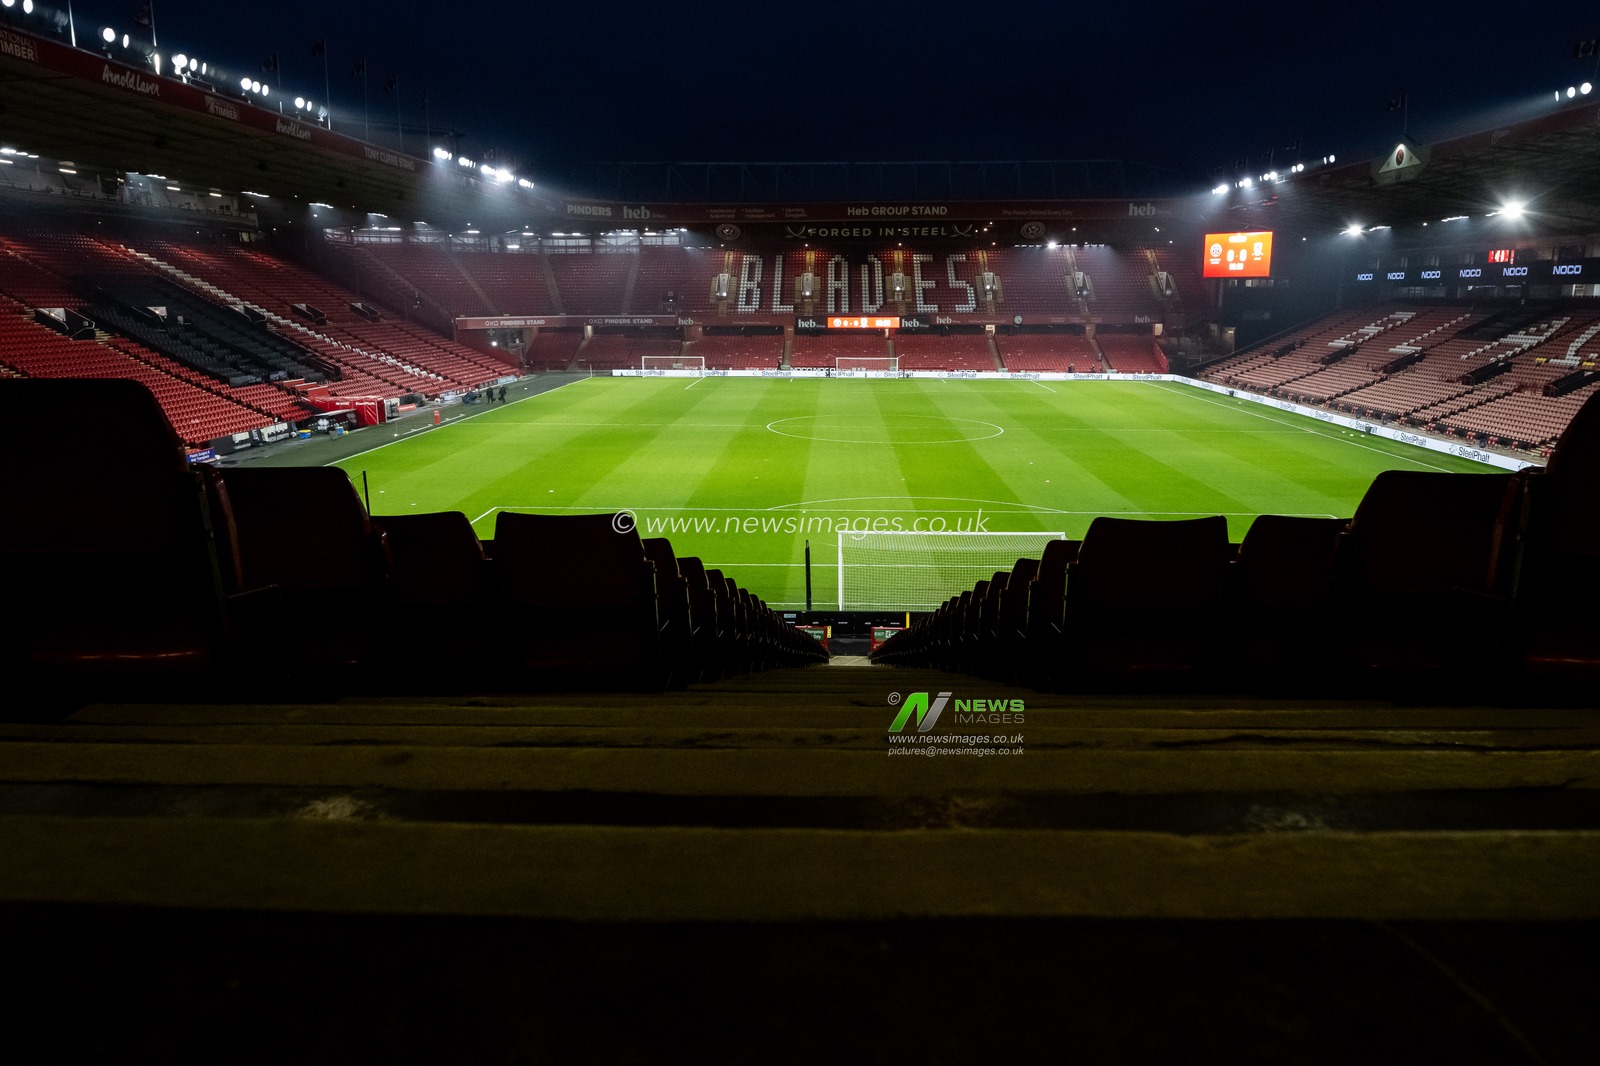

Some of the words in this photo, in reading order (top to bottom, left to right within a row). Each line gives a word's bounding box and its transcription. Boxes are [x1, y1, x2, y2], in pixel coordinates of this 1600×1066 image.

[0, 30, 33, 49] ATIONAL
[0, 39, 34, 61] IMBER
[103, 64, 134, 89] Arnold
[136, 74, 160, 97] Laver
[215, 105, 238, 120] TIMBER
[276, 118, 297, 137] Arnold
[296, 124, 311, 141] Laver
[364, 147, 379, 160] TONY
[380, 151, 399, 167] CURRIE
[399, 157, 415, 171] STAND
[566, 204, 612, 216] PINDERS
[622, 206, 650, 220] heb
[848, 206, 868, 216] Heb
[871, 206, 910, 216] GROUP
[912, 206, 948, 216] STAND
[1128, 202, 1156, 216] heb
[808, 228, 872, 237] FORGED
[880, 228, 895, 236] IN
[902, 227, 948, 236] STEEL
[1421, 270, 1440, 279] NOCO
[1460, 268, 1482, 278] NOCO
[1502, 266, 1528, 276] NOCO
[1552, 264, 1582, 275] NOCO
[1387, 272, 1405, 280] NOCO
[738, 254, 976, 314] BLADES
[678, 318, 694, 326] heb
[798, 319, 816, 328] heb
[902, 318, 919, 328] heb
[936, 316, 952, 324] heb
[1134, 315, 1150, 323] heb
[1400, 432, 1428, 448] SteelPhalt
[1458, 446, 1491, 464] SteelPhalt
